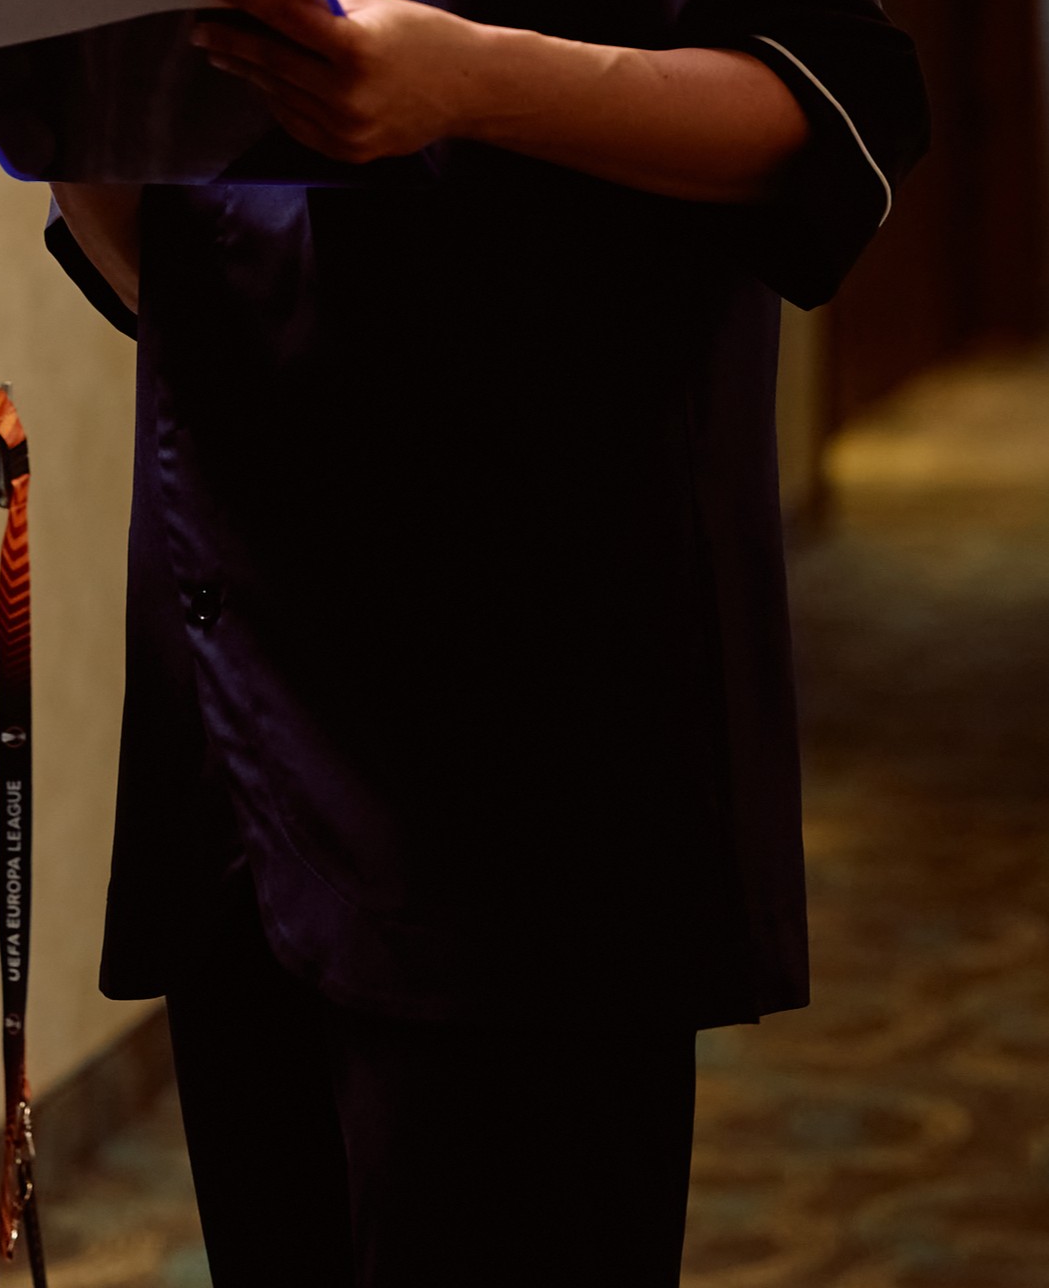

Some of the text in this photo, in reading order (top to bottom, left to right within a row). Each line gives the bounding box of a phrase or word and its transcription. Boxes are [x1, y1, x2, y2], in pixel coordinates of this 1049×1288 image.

[7, 781, 21, 982] UEFA EUROPA LEAGUE
